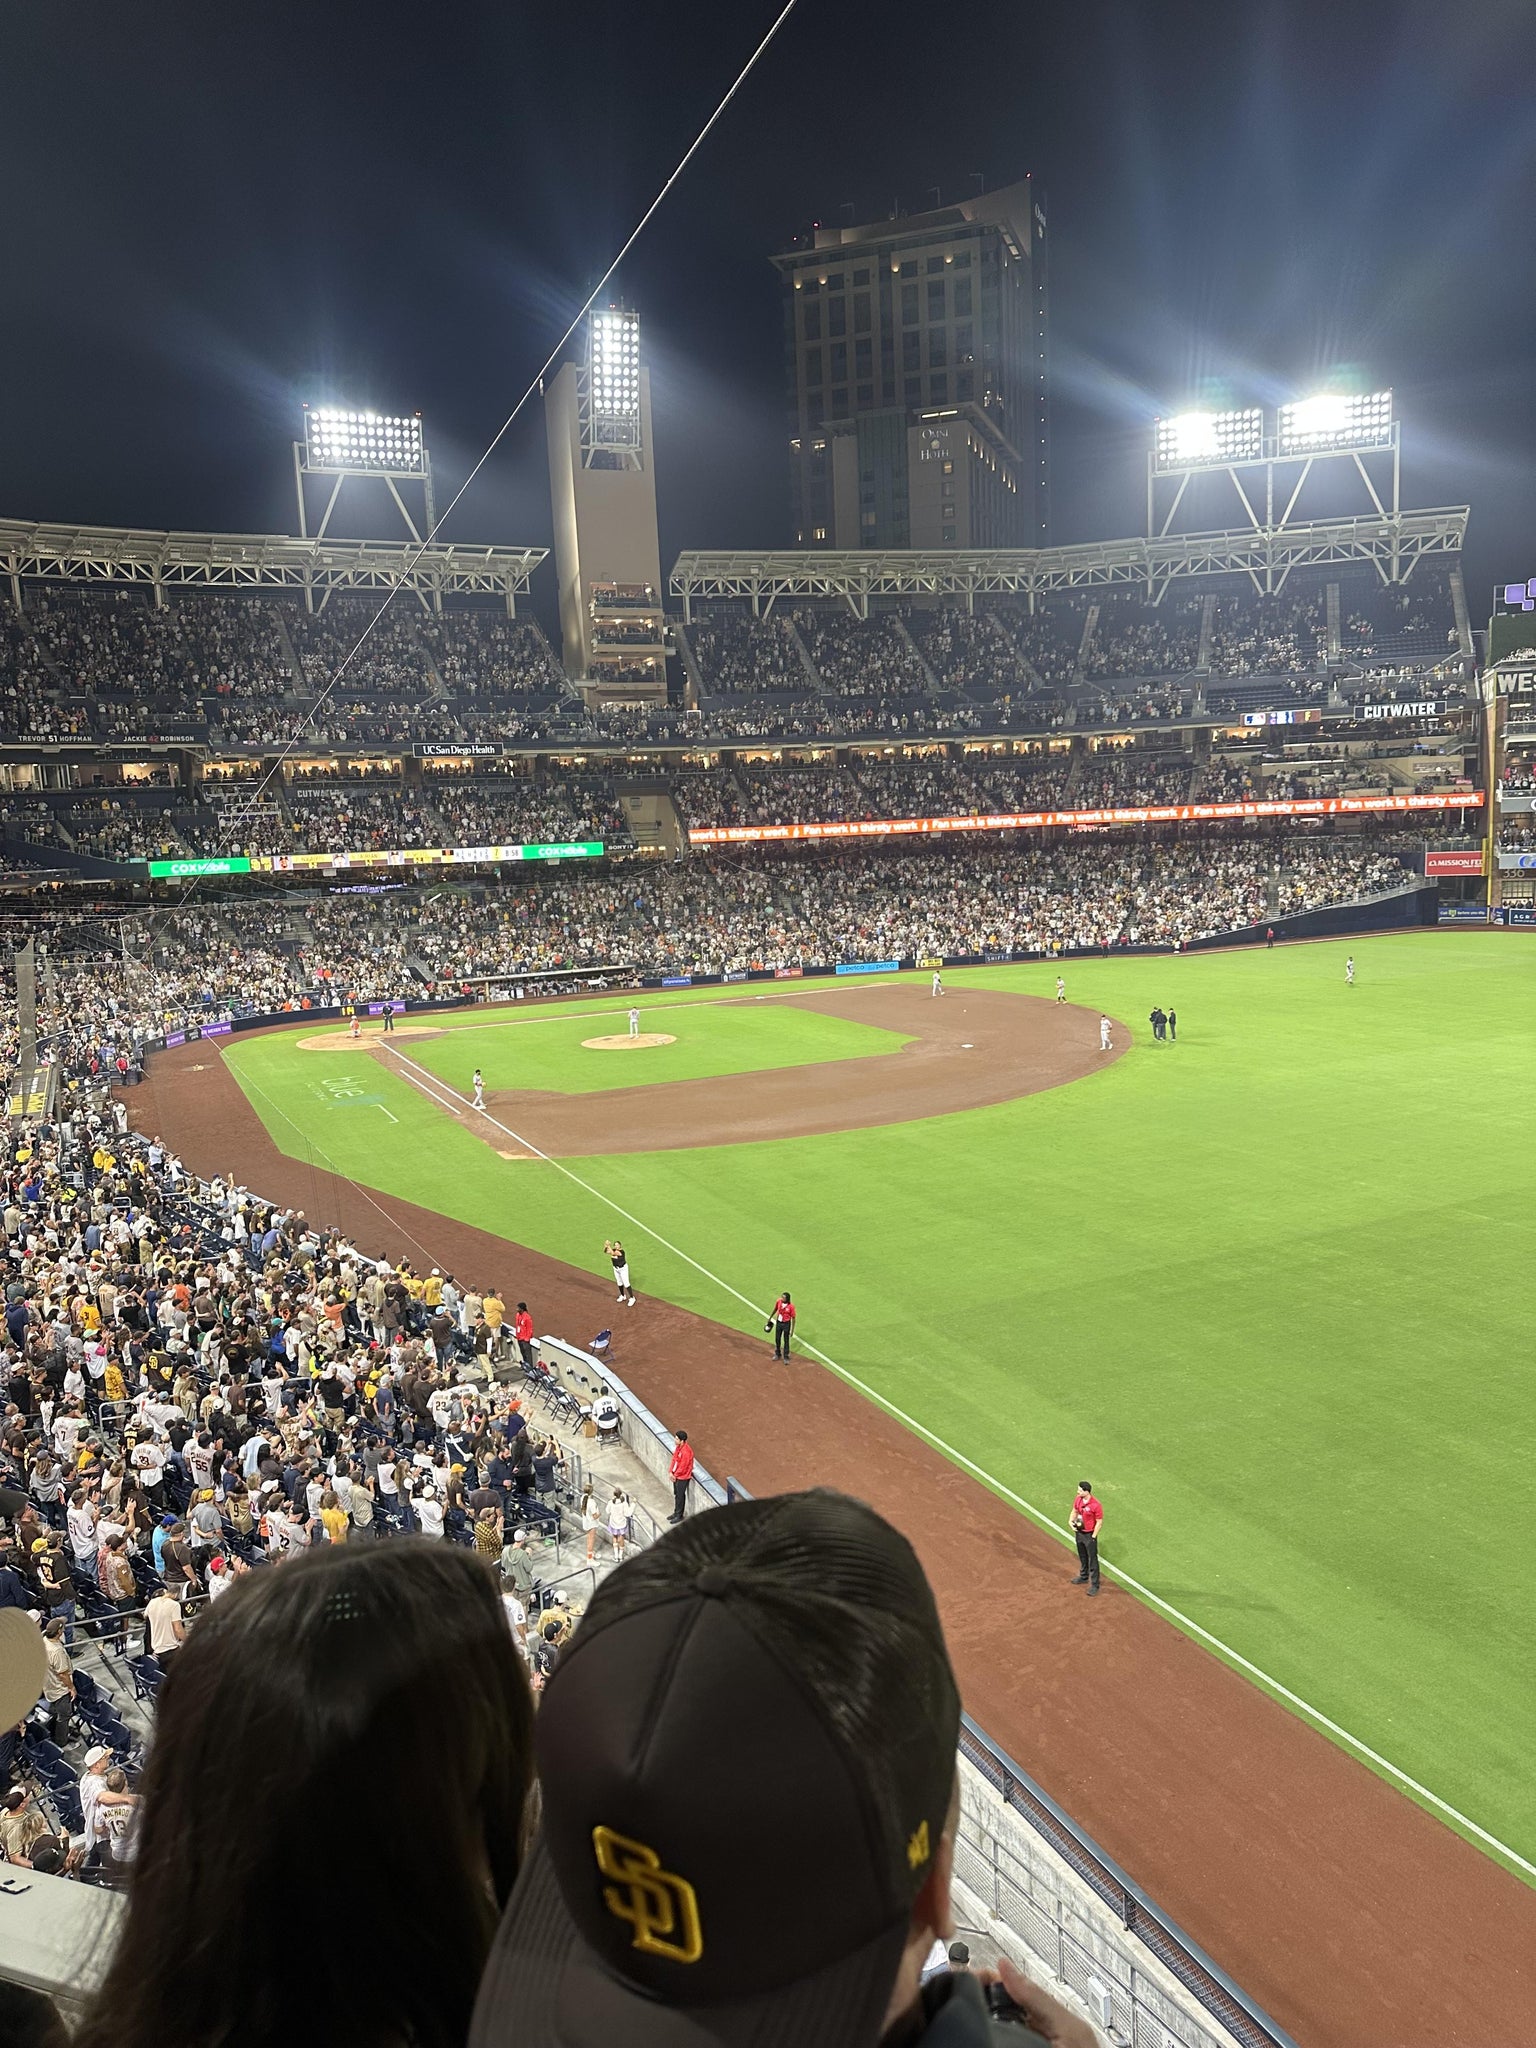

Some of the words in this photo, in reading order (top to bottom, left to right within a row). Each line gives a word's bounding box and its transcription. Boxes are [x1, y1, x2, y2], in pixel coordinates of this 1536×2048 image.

[1497, 673, 1536, 693] WE
[1364, 702, 1435, 718] CUTWATER
[423, 745, 436, 754] UC
[436, 745, 450, 754] San
[451, 745, 471, 756] Diego
[472, 745, 495, 754] Health
[1341, 800, 1362, 809] Fan
[1364, 798, 1394, 808] work
[1396, 797, 1406, 807] is
[1408, 796, 1447, 807] thirsty
[1448, 794, 1479, 804] work
[1193, 807, 1214, 815] Fan
[1215, 805, 1243, 814] work
[1245, 804, 1255, 813] is
[1256, 803, 1294, 813] thirsty
[1295, 801, 1325, 811] work
[1056, 813, 1074, 822] Fan
[1076, 812, 1102, 821] work
[1103, 811, 1112, 820] is
[1114, 810, 1149, 820] thirsty
[1150, 808, 1177, 818] work
[932, 819, 949, 828] Fan
[951, 818, 976, 827] work
[977, 817, 985, 826] is
[987, 816, 1017, 827] thirsty
[1019, 815, 1042, 824] work
[690, 830, 716, 839] work
[718, 830, 727, 838] is
[729, 828, 761, 839] thirsty
[763, 827, 788, 837] work
[804, 826, 822, 835] Fan
[823, 824, 848, 834] work
[850, 823, 858, 832] is
[860, 822, 891, 832] thirsty
[893, 821, 918, 831] work
[538, 847, 560, 856] COX
[171, 864, 197, 873] COX
[1503, 869, 1525, 878] 330
[846, 964, 865, 972] petco
[876, 962, 895, 970] petco
[195, 1460, 208, 1472] 55
[233, 1503, 239, 1518] 9
[103, 1808, 130, 1819] MACHADO
